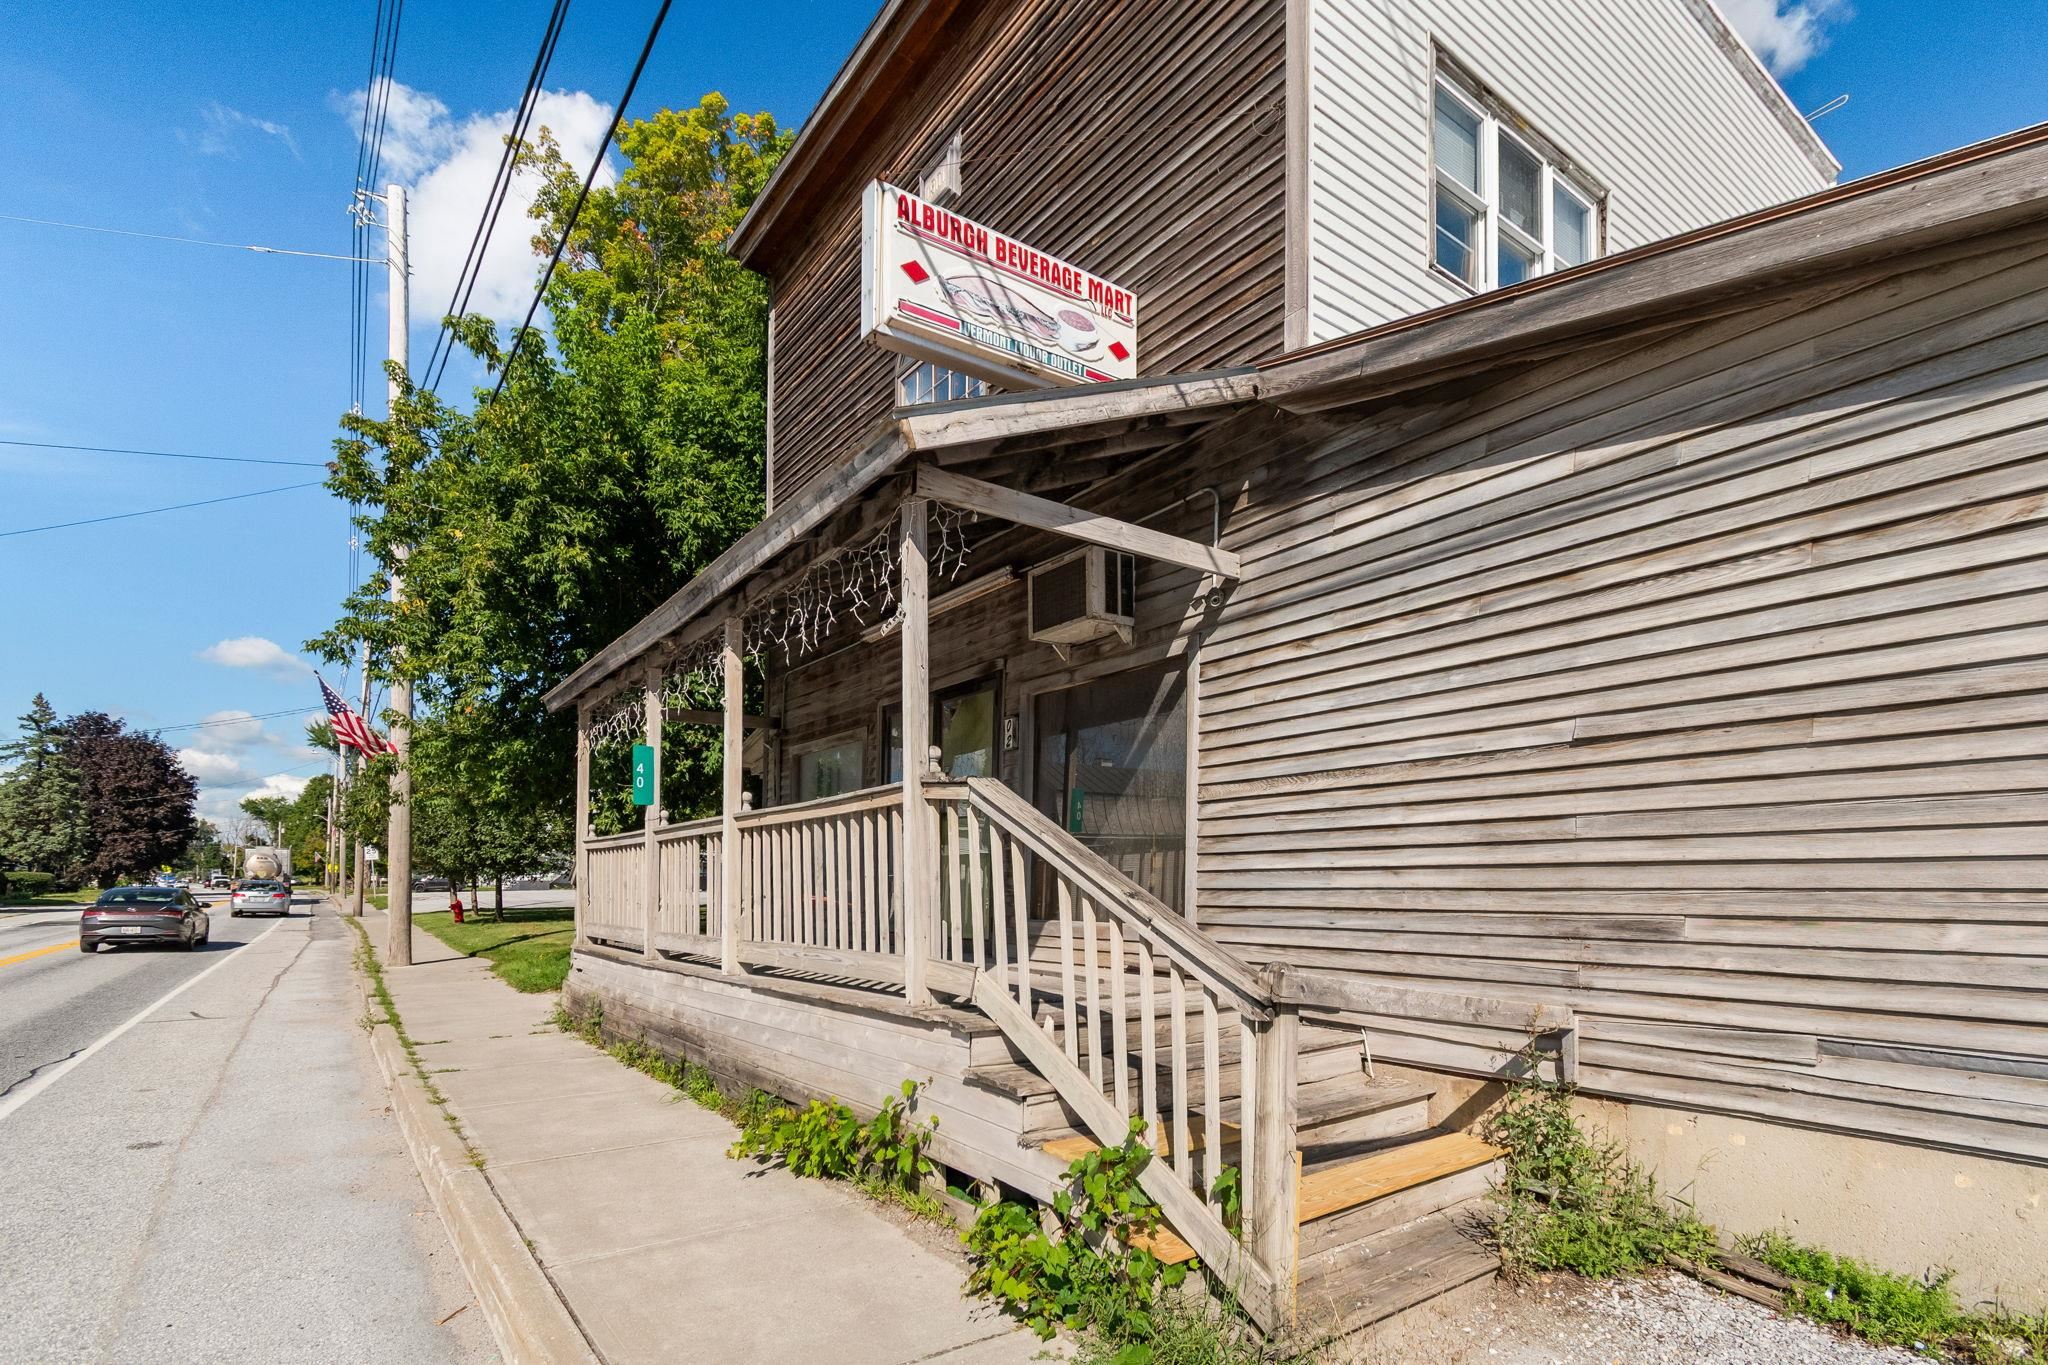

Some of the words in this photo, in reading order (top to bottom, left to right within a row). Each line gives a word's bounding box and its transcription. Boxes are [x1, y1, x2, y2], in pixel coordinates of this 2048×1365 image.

[897, 194, 988, 256] ALBURGH
[996, 236, 1082, 295] BEVERAGE
[1088, 277, 1132, 316] MART
[961, 321, 1011, 350] VERMONT
[1015, 341, 1048, 364] LIQUOR
[1051, 353, 1083, 376] OUTLET
[636, 763, 644, 788] 40
